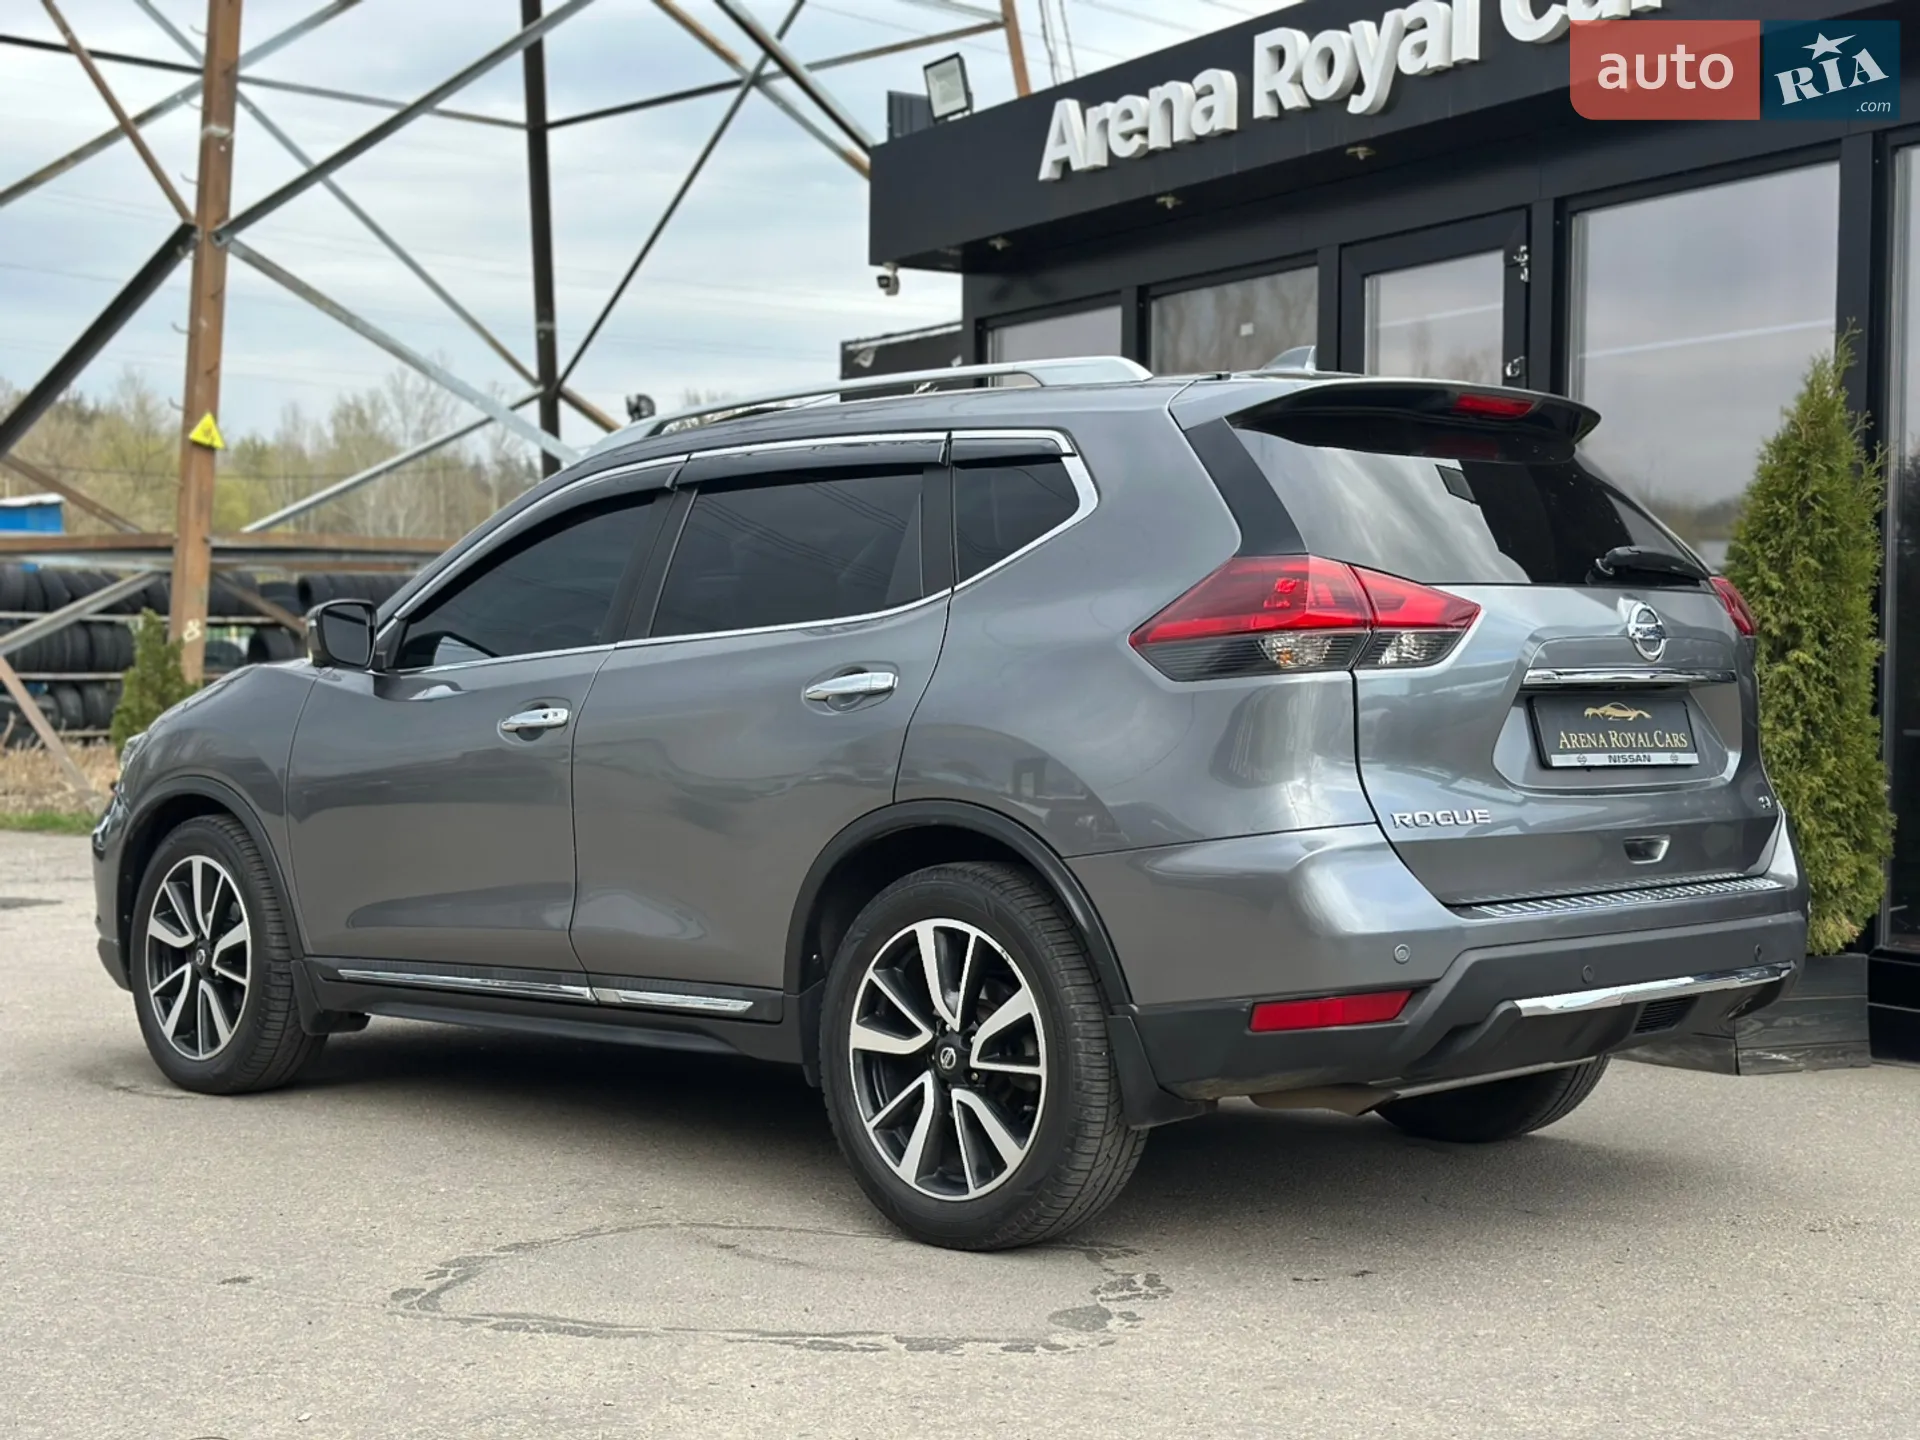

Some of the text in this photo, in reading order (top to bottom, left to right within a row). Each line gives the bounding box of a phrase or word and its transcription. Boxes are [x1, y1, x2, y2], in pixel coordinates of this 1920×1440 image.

[1038, 0, 1480, 181] Arena Royal
[1559, 730, 1688, 749] ARENA ROYAL CARS
[1608, 754, 1651, 763] NISSAN
[1391, 809, 1492, 829] ROGUE
